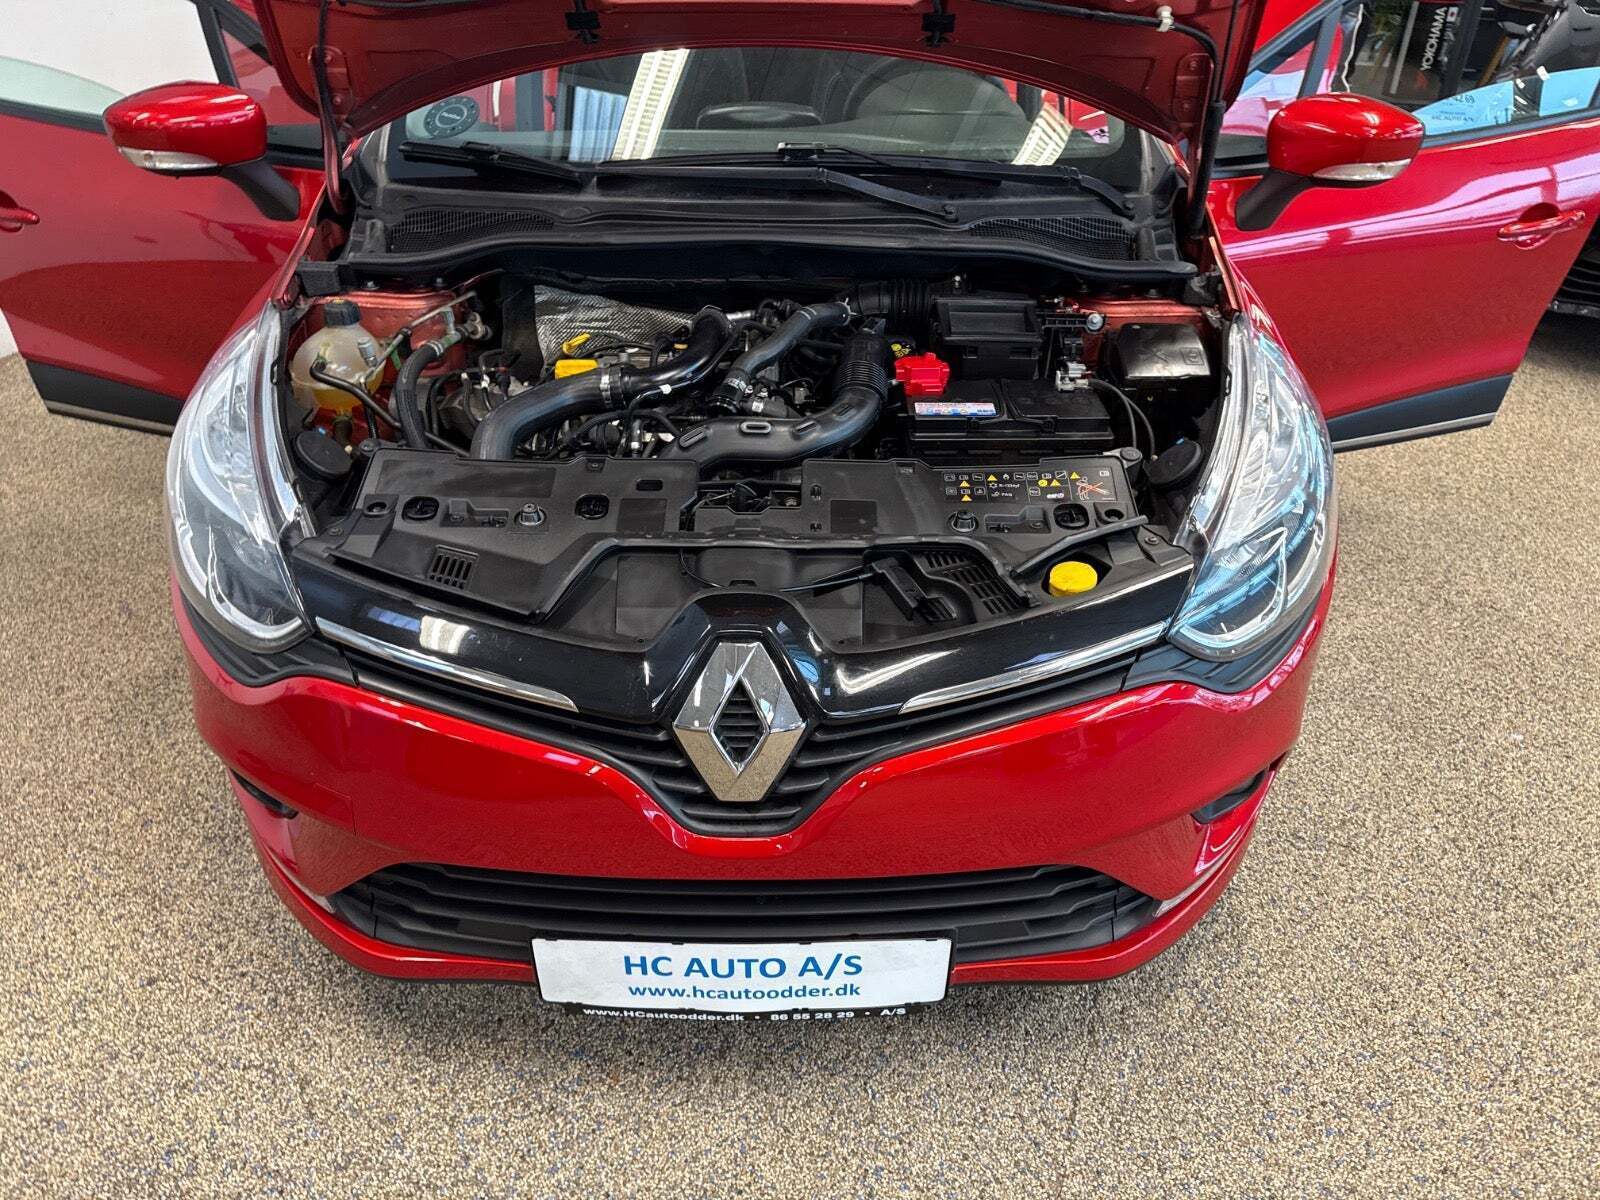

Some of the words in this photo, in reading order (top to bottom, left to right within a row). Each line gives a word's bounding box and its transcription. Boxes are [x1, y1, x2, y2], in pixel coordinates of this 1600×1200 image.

[1420, 7, 1447, 70] YOKOHAMA
[623, 955, 673, 976] HC
[683, 957, 787, 979] AUTO
[798, 953, 863, 980] A/S
[628, 983, 861, 1000] www.hcautoodder.dk
[583, 1008, 744, 1021] www.HCautoodder.dk
[880, 1008, 907, 1016] A/S
